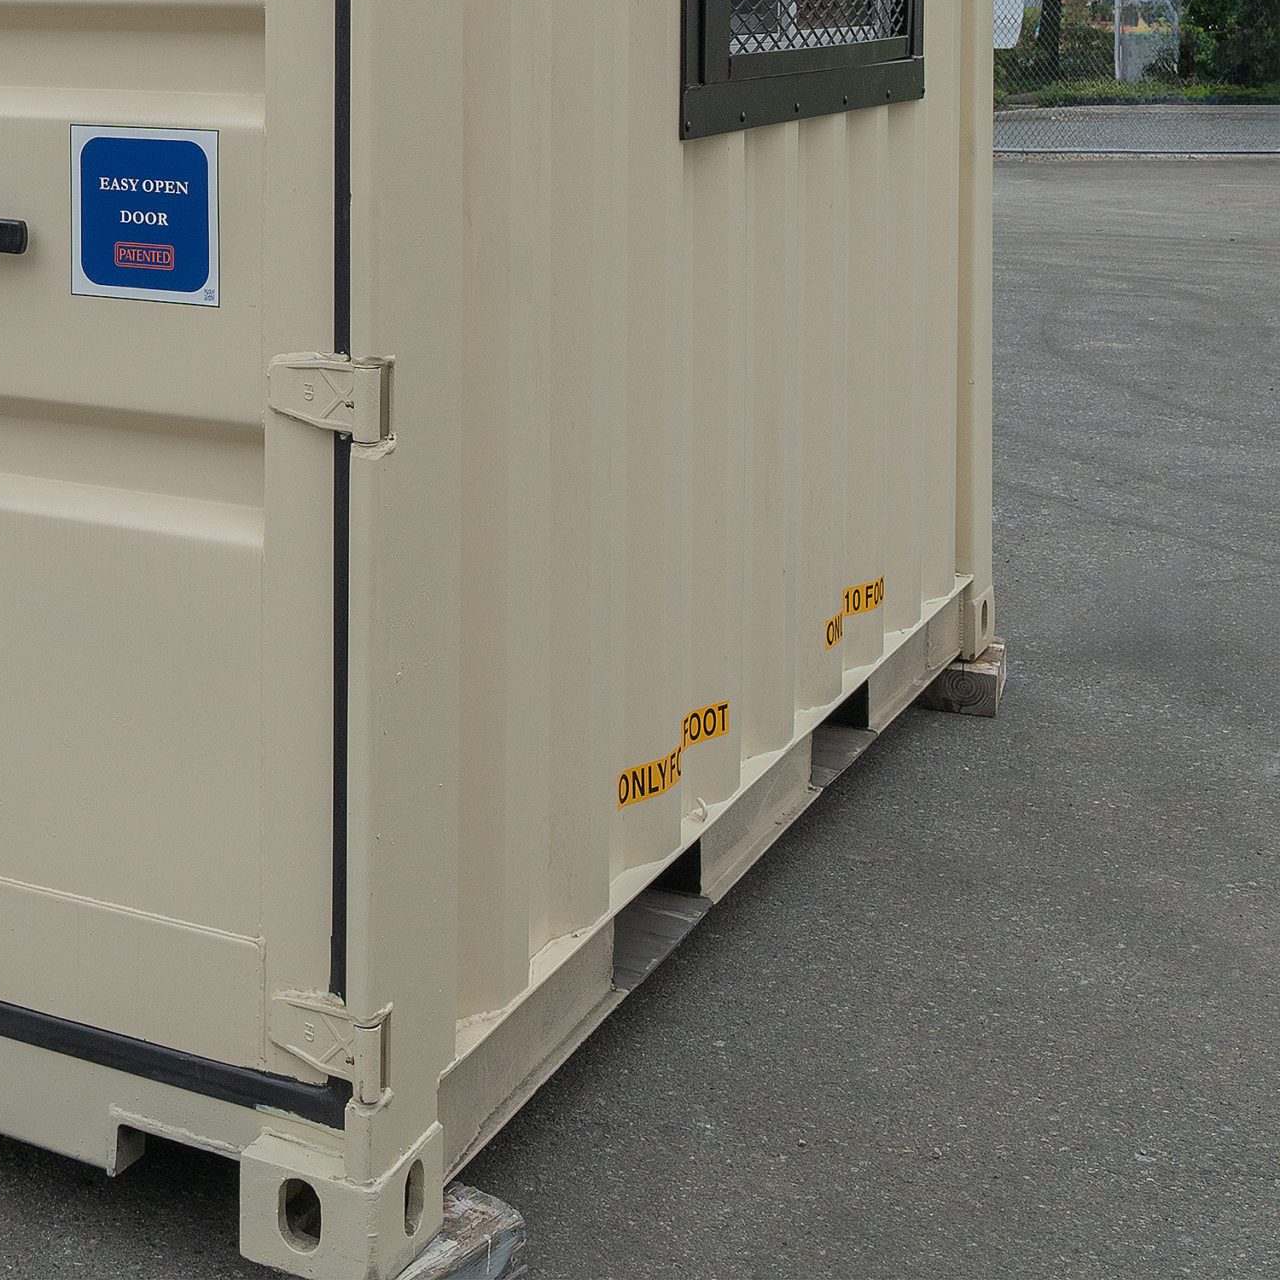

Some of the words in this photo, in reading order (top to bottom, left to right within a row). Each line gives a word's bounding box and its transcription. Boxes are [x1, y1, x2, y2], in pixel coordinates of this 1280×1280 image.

[99, 176, 139, 192] EASY
[142, 179, 189, 195] OPEN
[120, 210, 169, 226] DOOR
[119, 248, 171, 264] PATENTED
[844, 590, 861, 613] 10
[865, 577, 884, 609] FOO
[683, 704, 728, 747] FOOT
